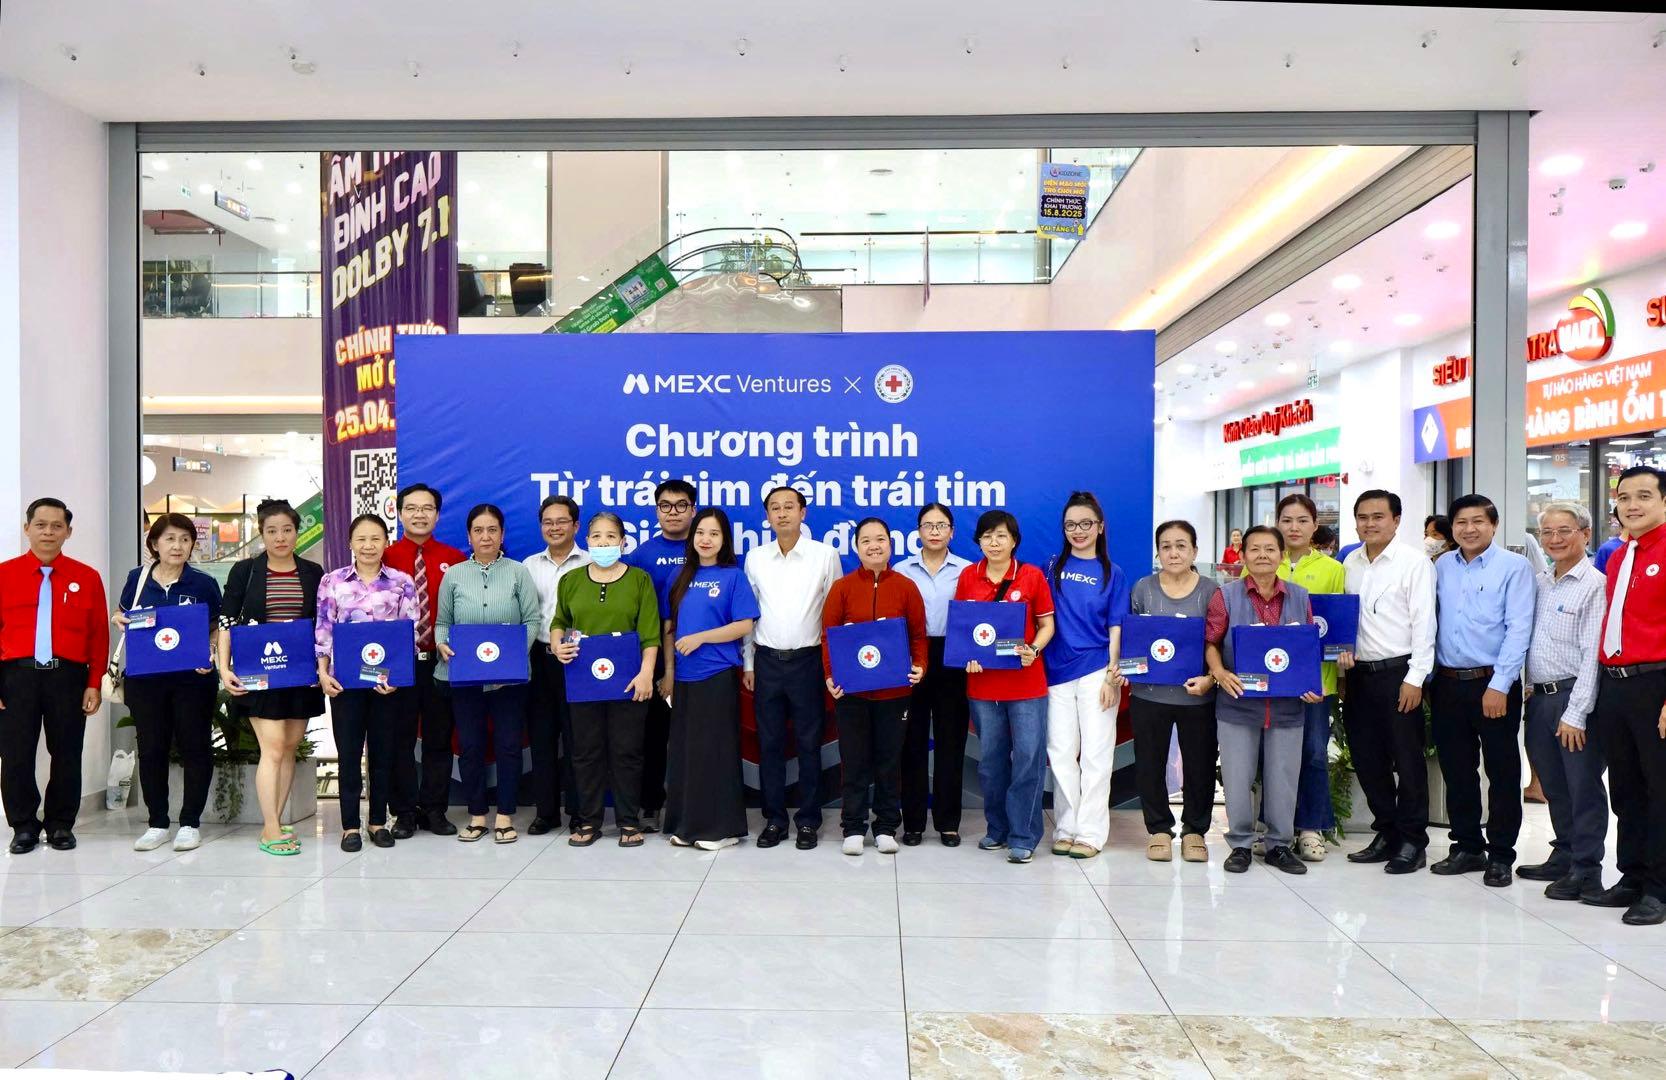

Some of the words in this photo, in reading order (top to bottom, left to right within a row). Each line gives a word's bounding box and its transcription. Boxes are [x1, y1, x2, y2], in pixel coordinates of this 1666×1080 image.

[330, 152, 362, 205] ÂM
[393, 152, 442, 213] CAO
[1043, 209, 1082, 217] 15.8.2025
[332, 222, 410, 310] DOLBY
[418, 195, 451, 252] 7.1
[335, 325, 393, 366] CHÍNH
[356, 354, 385, 392] MỞ
[654, 374, 731, 394] MEXC
[736, 374, 832, 394] Ventures
[1626, 360, 1652, 381] NAM
[335, 398, 396, 442] 25.04.
[625, 422, 803, 467] Chương
[813, 421, 918, 457] trình
[851, 470, 925, 507] trái
[934, 470, 1006, 507] tim
[693, 581, 720, 589] MEXC
[1065, 571, 1098, 586] MEXC
[260, 655, 289, 665] MEXC
